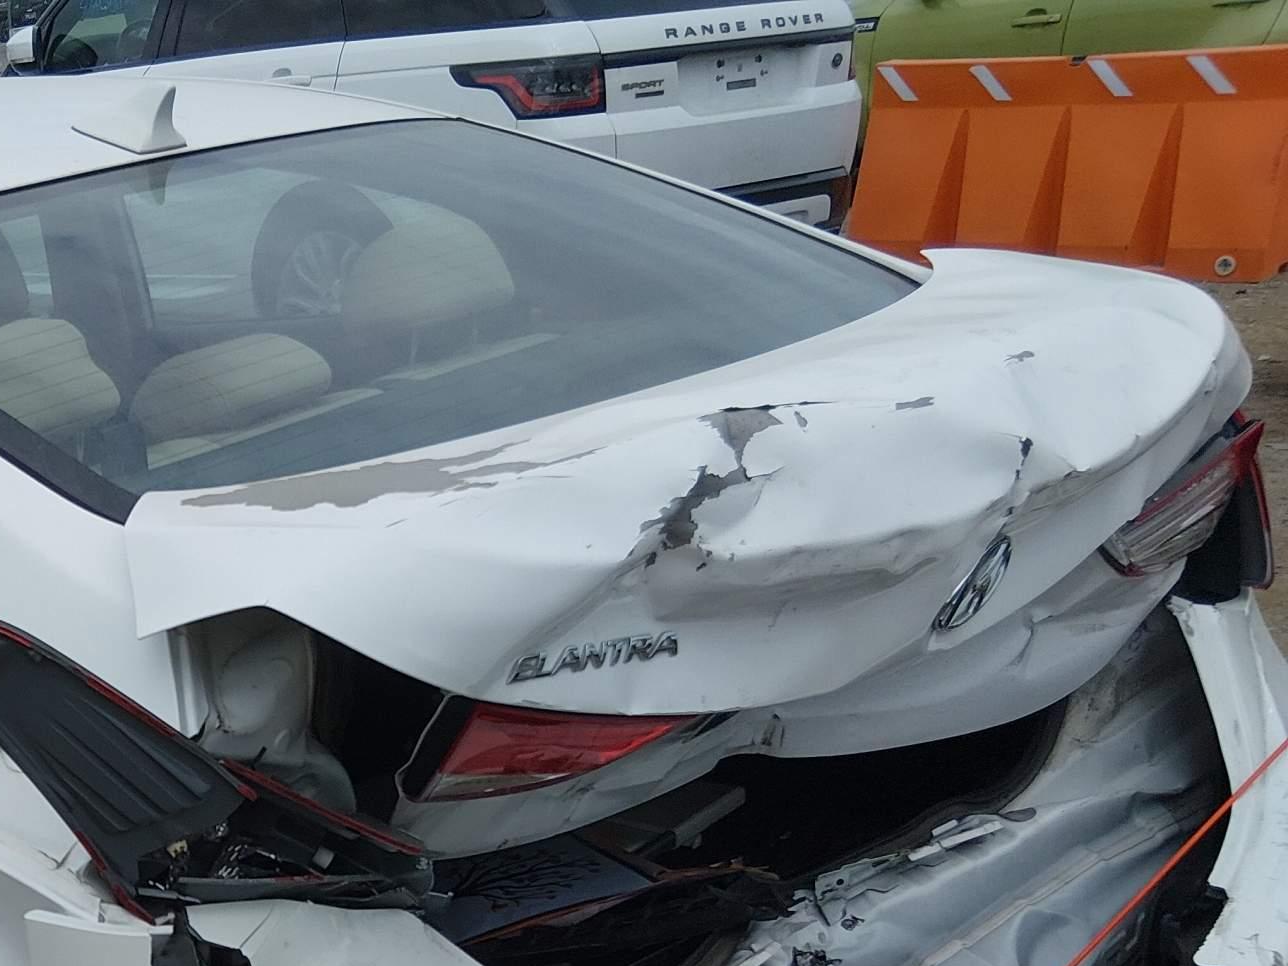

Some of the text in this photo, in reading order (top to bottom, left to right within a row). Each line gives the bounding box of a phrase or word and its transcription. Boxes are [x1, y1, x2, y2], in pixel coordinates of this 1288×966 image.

[664, 12, 825, 40] RANGE ROVER
[621, 79, 665, 91] SPORT
[505, 630, 679, 685] ELANTRA
